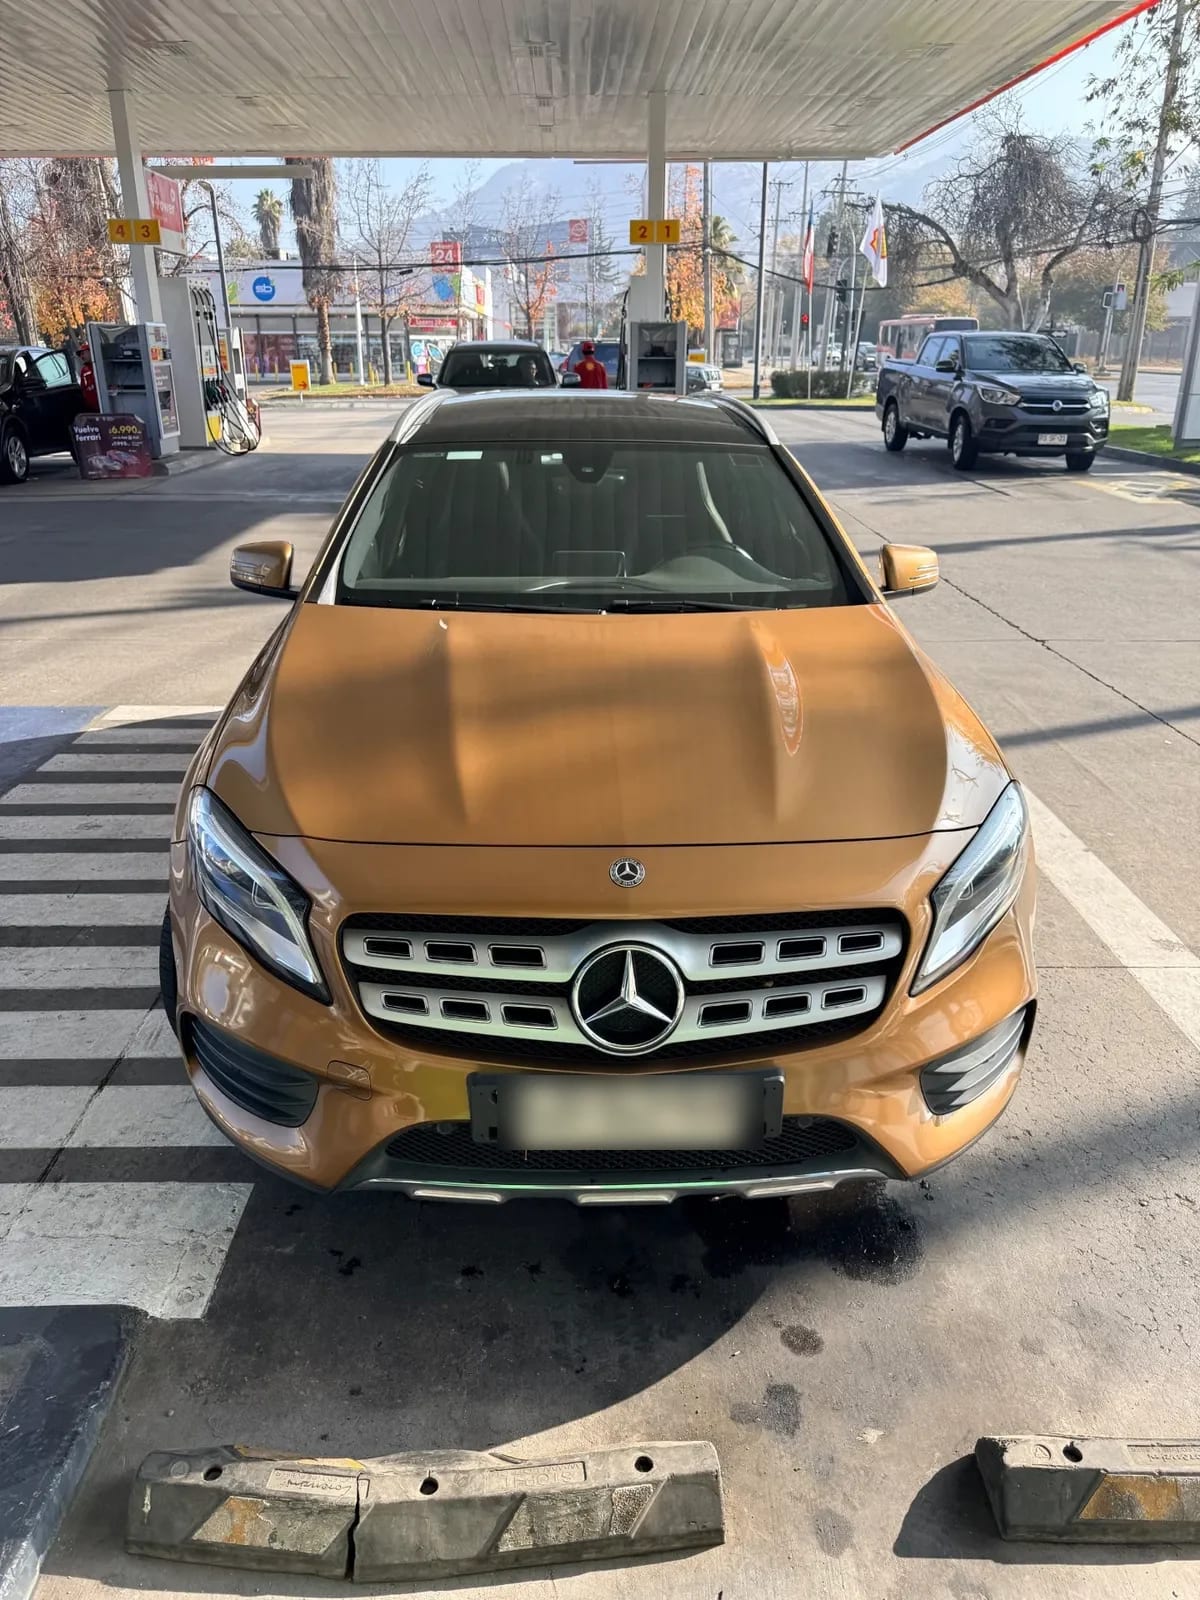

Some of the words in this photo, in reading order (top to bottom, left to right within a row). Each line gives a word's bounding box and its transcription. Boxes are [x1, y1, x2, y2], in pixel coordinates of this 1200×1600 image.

[115, 225, 126, 238] 4
[141, 225, 151, 238] 3
[638, 225, 648, 238] 2
[664, 225, 671, 238] 1
[436, 249, 454, 264] 24
[255, 283, 273, 294] sb
[73, 425, 99, 433] Vuelve
